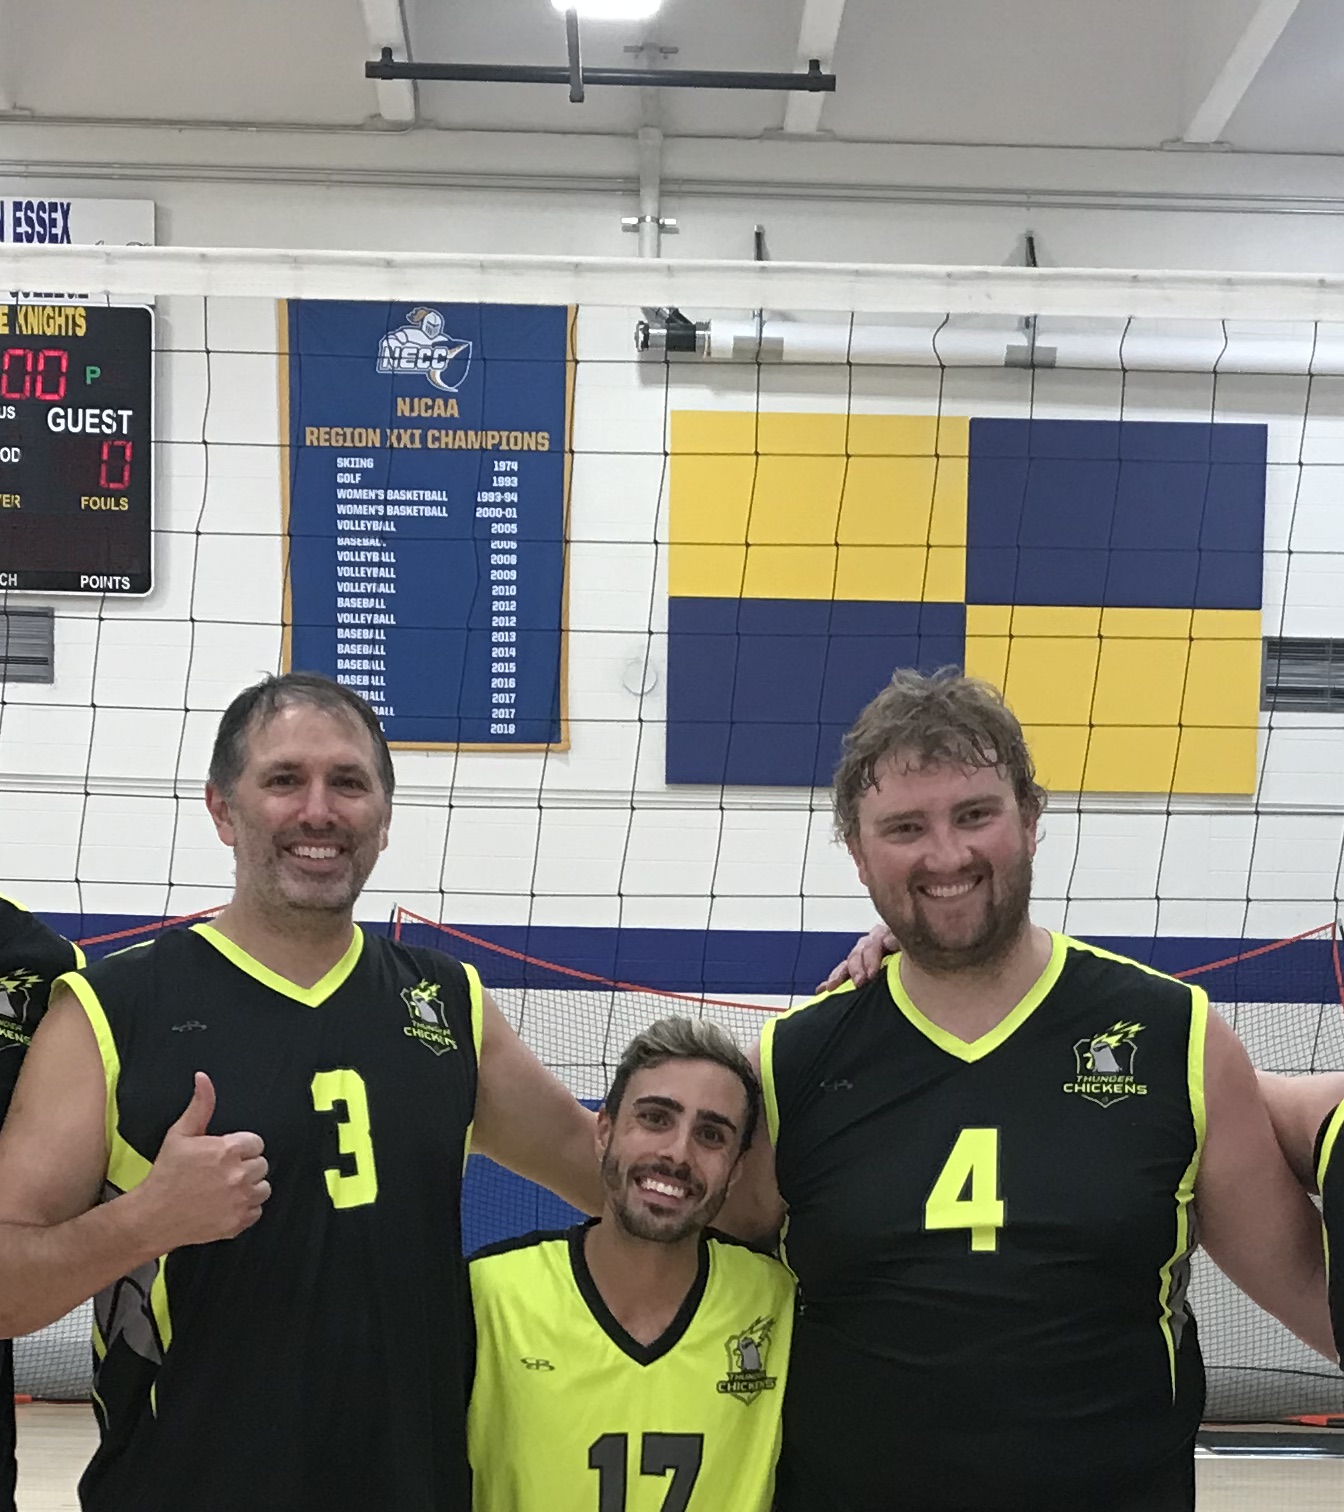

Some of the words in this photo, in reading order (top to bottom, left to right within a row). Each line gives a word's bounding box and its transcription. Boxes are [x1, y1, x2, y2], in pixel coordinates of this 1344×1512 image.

[12, 200, 72, 245] ESSEX
[16, 306, 87, 337] KNIGHTS
[382, 346, 449, 370] NECC
[85, 366, 102, 385] P
[396, 397, 460, 418] NJCAA
[47, 407, 134, 435] GUEST
[305, 426, 381, 448] REGION
[386, 428, 423, 450] XXI
[427, 430, 551, 452] CHAMPIONS
[98, 439, 133, 491] 0
[336, 457, 374, 468] SKIING
[493, 460, 519, 472] 1974
[336, 472, 362, 484] GOLF
[492, 475, 518, 488] 1993
[336, 488, 385, 500] WOMEN'S
[386, 489, 449, 502] BASKETBALL
[81, 496, 129, 511] FOULS
[336, 503, 385, 516] WOMEN'S
[386, 505, 449, 518] BASKETBALL
[476, 507, 518, 519] 2000-01
[336, 519, 397, 532] VOLLEYBALL
[491, 523, 518, 535] 2005
[336, 566, 397, 578] VOLLEYBALL
[490, 569, 517, 581] 2009
[80, 574, 131, 590] POINTS
[491, 585, 517, 596] 2010
[336, 597, 387, 609] BASEBALL
[492, 600, 517, 612] 2012
[336, 612, 397, 625] VOLLEYBALL
[491, 616, 517, 627] 2012
[491, 631, 517, 642] 2013
[491, 647, 516, 658] 2014
[491, 662, 516, 673] 2015
[490, 677, 516, 689] 2016
[491, 693, 516, 704] 2017
[491, 708, 516, 719] 2017
[490, 723, 516, 735] 2018
[1076, 1075, 1134, 1083] THUNDER
[1063, 1083, 1148, 1095] CHICKENS
[311, 1069, 379, 1209] 3
[925, 1128, 1004, 1251] 4
